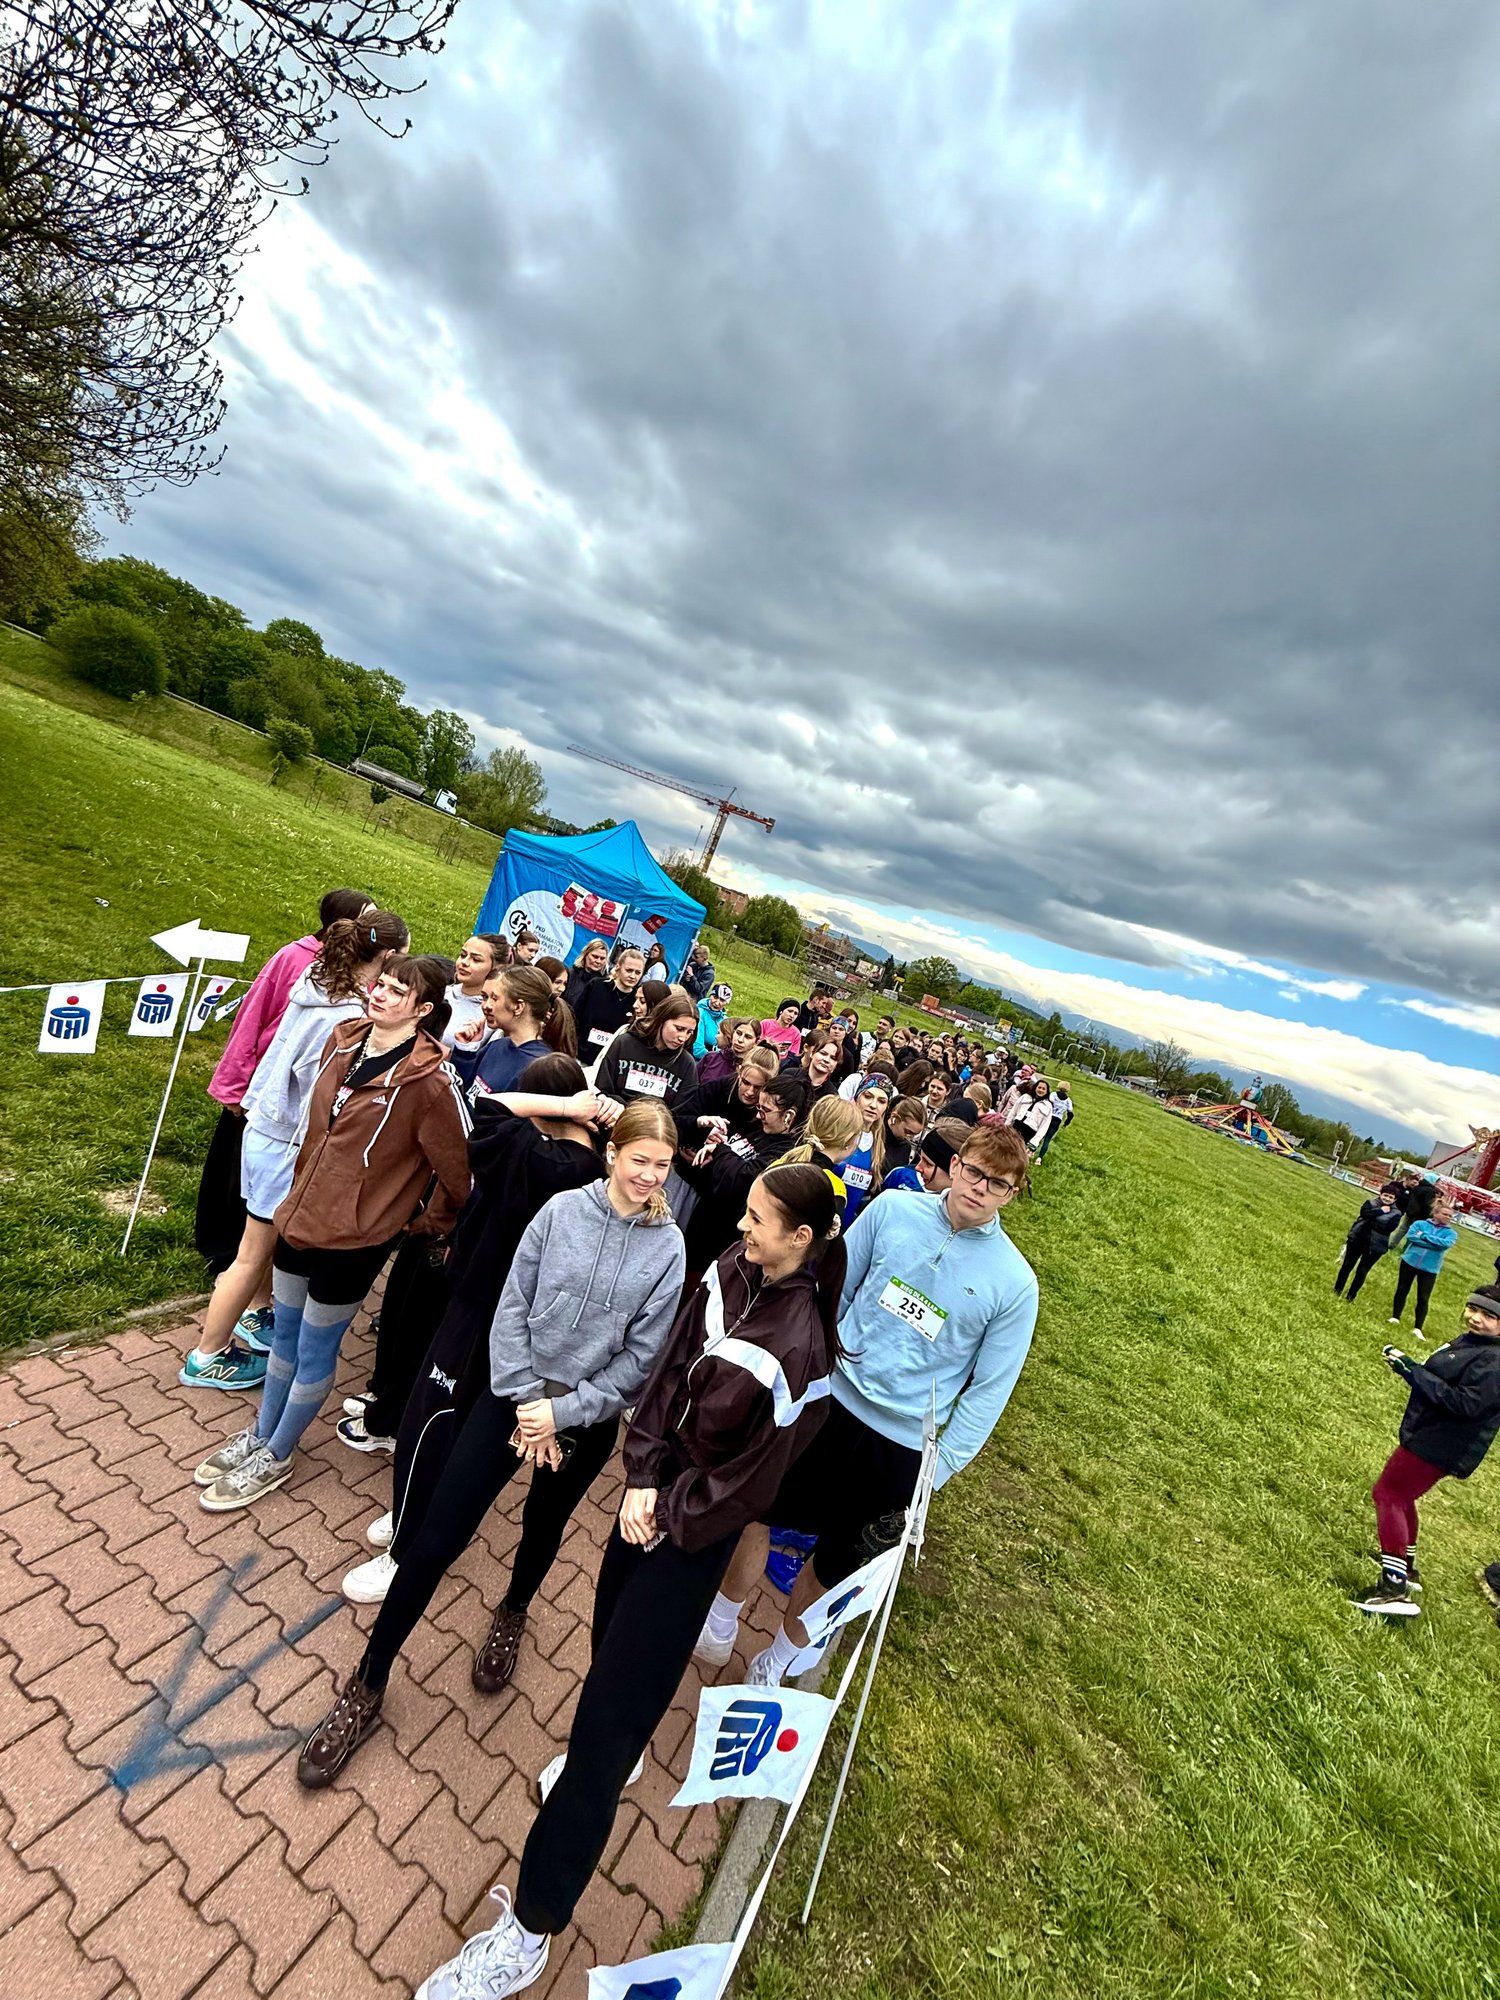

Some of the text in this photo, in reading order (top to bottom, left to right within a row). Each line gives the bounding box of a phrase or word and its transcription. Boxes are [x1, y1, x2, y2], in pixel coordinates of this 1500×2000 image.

[535, 925, 546, 933] PKO
[596, 1034, 609, 1043] 059
[638, 1078, 655, 1089] 037
[850, 1172, 864, 1183] 070
[912, 1291, 925, 1302] DLA
[898, 1297, 926, 1321] 255
[709, 1699, 783, 1781] PKO
